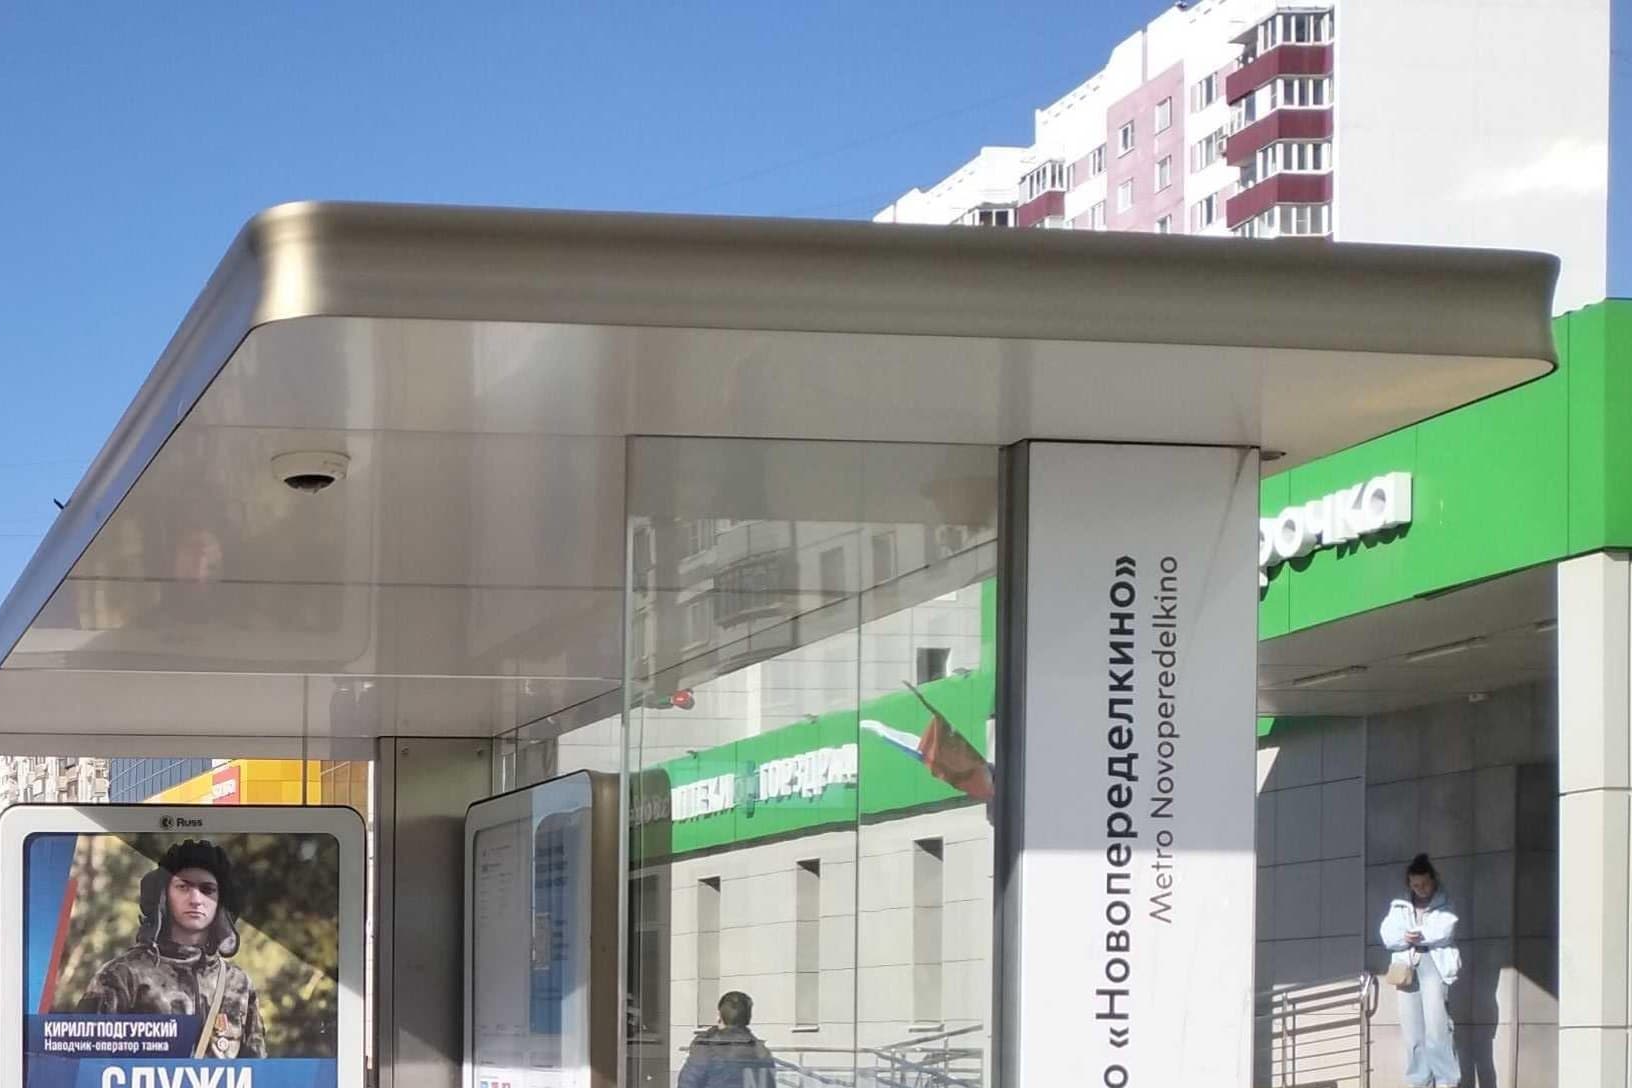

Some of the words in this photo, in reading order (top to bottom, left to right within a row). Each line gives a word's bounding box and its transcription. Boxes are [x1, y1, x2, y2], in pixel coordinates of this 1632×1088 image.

[1150, 556, 1180, 819] Novoperedelkino
[176, 818, 203, 828] Russ
[1095, 555, 1139, 1049] «Новопеределкино»
[1149, 829, 1174, 924] Metro
[44, 1021, 94, 1037] КИРИЛЛ
[97, 1019, 177, 1038] ПОДГУРСКИЙ
[44, 1039, 139, 1053] Наводчик-оператор
[142, 1041, 169, 1051] танка
